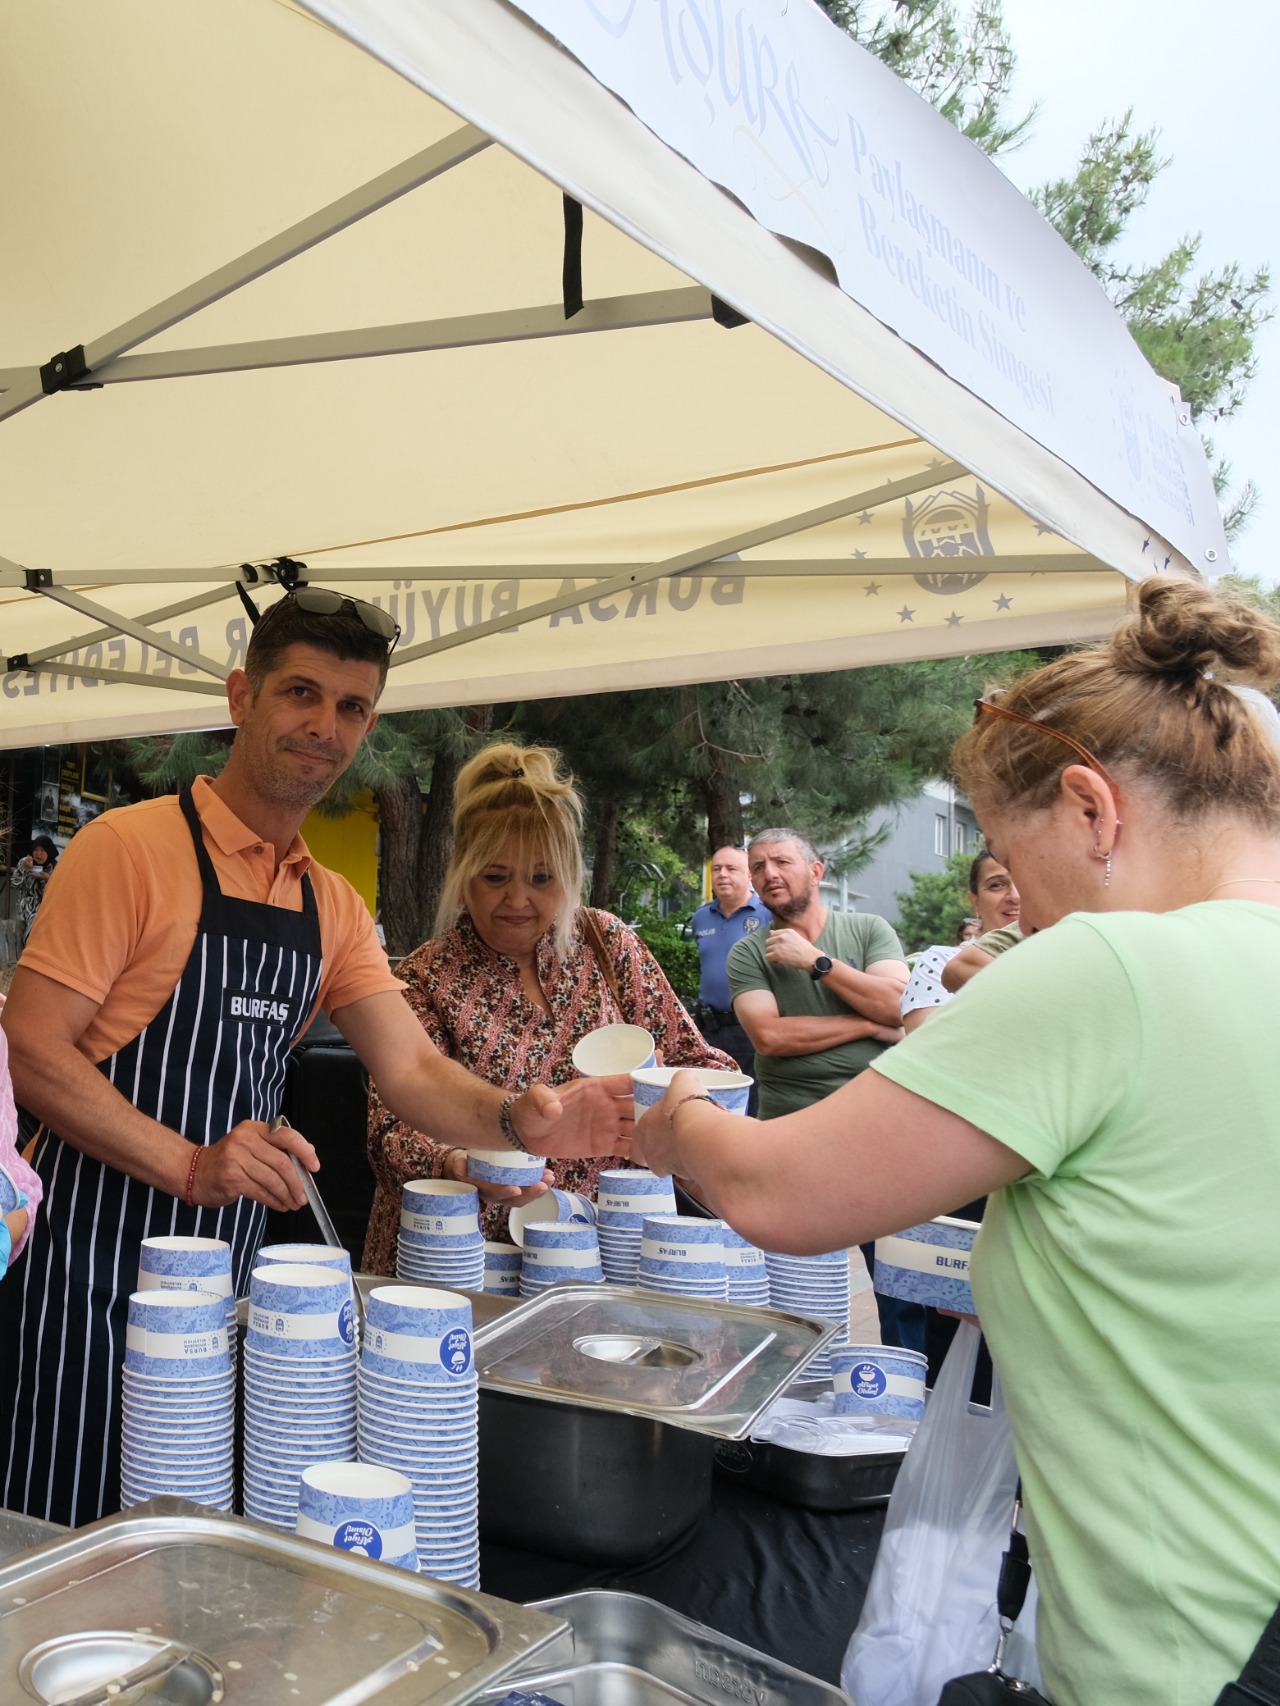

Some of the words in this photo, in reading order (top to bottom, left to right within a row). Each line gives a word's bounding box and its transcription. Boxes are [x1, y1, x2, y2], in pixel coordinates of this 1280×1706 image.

[847, 113, 1003, 311] Paylaşmanın
[1004, 281, 1026, 333] ve
[857, 193, 977, 352] Bereketin
[230, 996, 290, 1025] BURFAŞ
[935, 1255, 970, 1271] BURF
